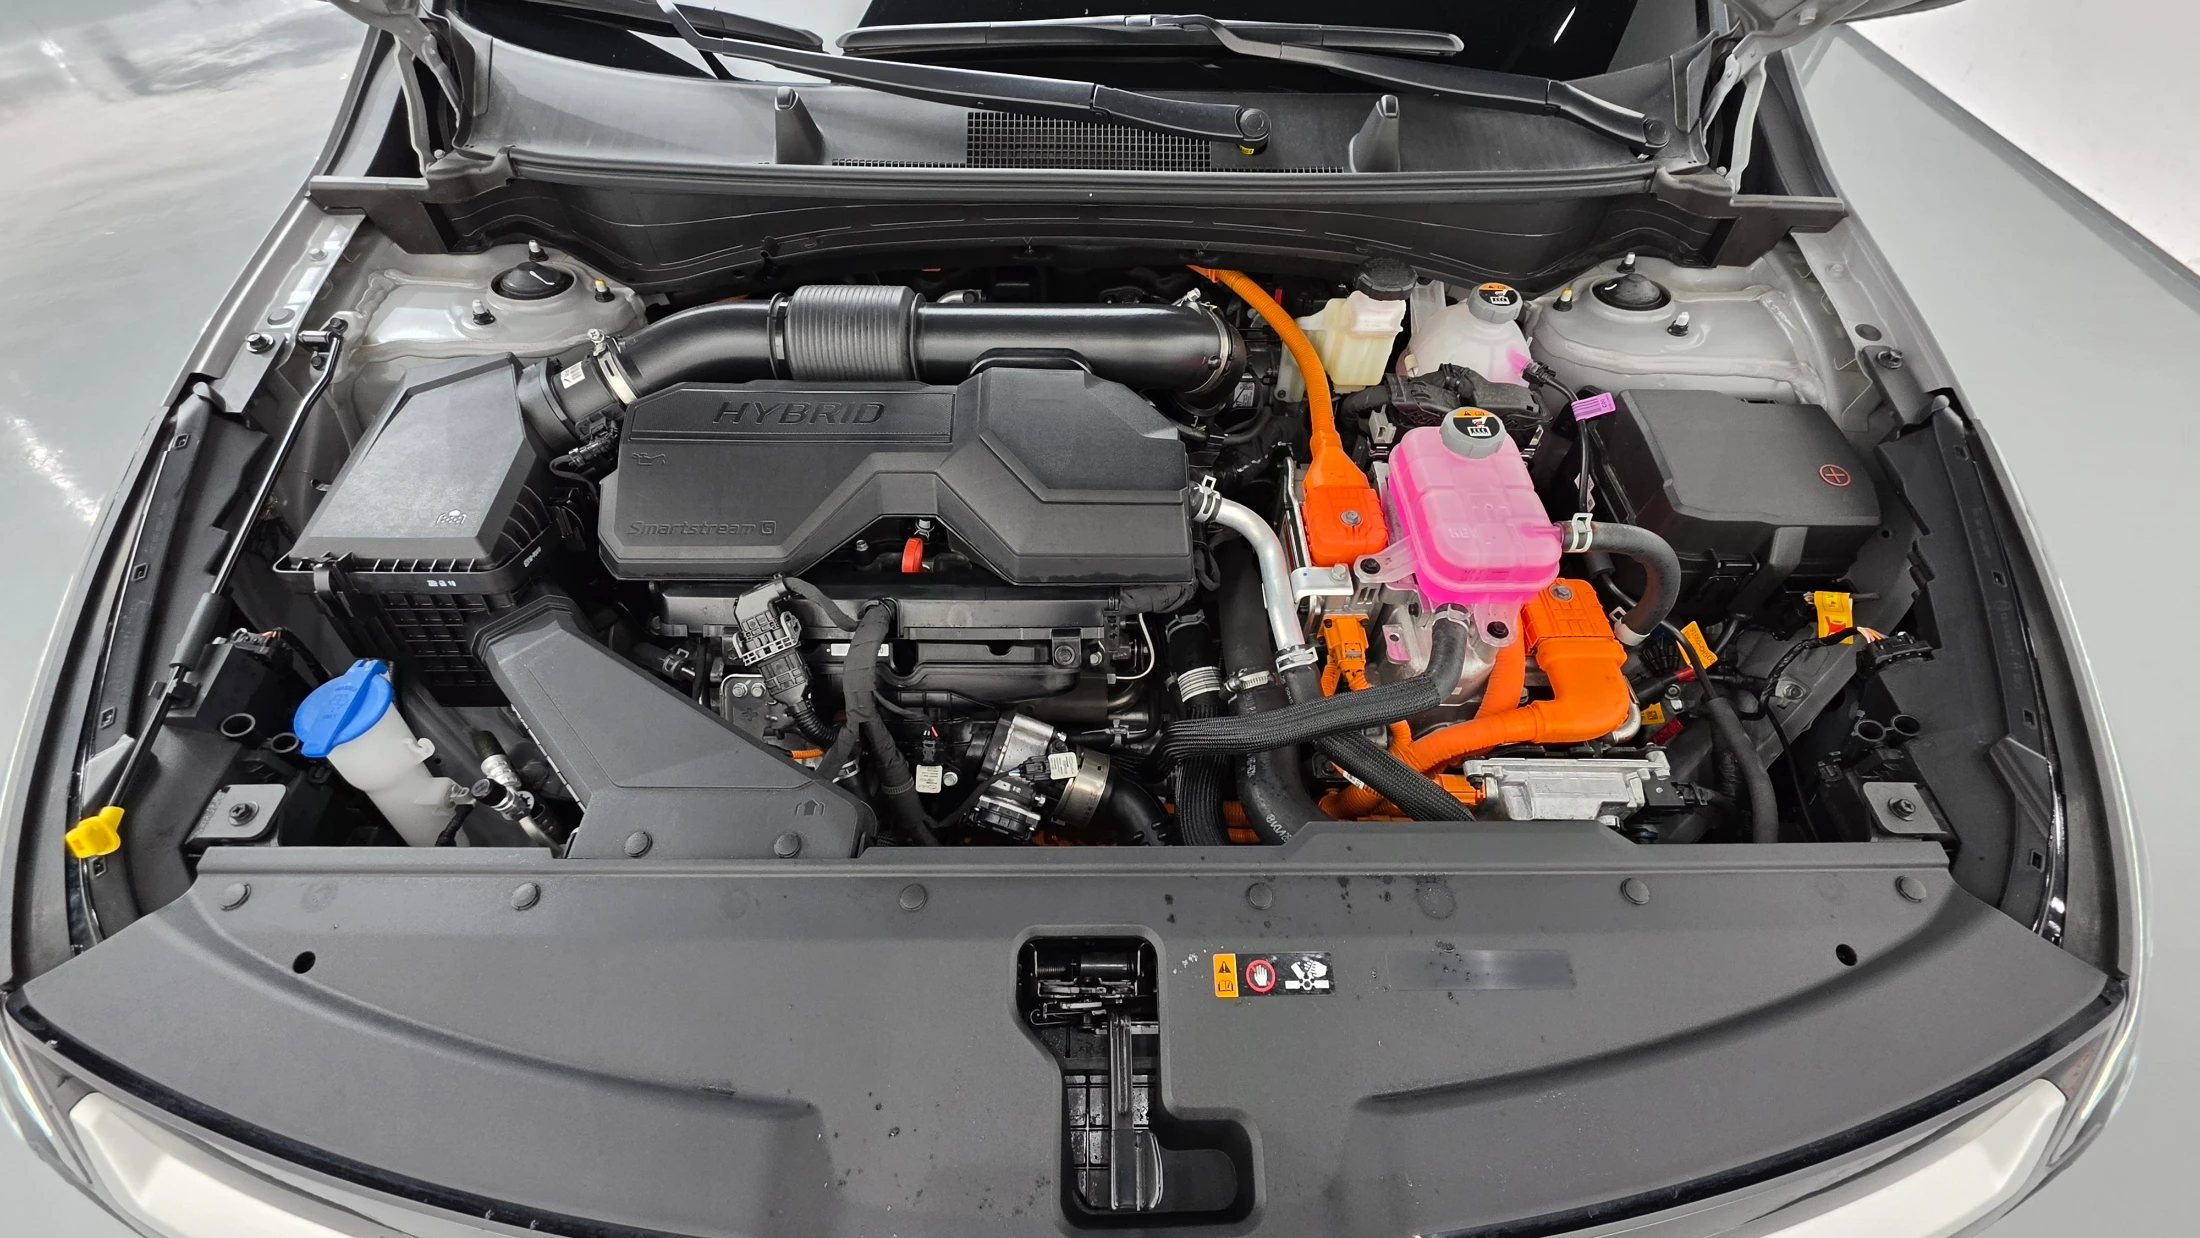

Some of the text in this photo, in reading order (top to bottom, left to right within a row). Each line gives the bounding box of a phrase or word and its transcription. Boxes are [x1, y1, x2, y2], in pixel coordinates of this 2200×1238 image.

[712, 401, 886, 425] HYBRID
[627, 520, 777, 536] Smartstream G
